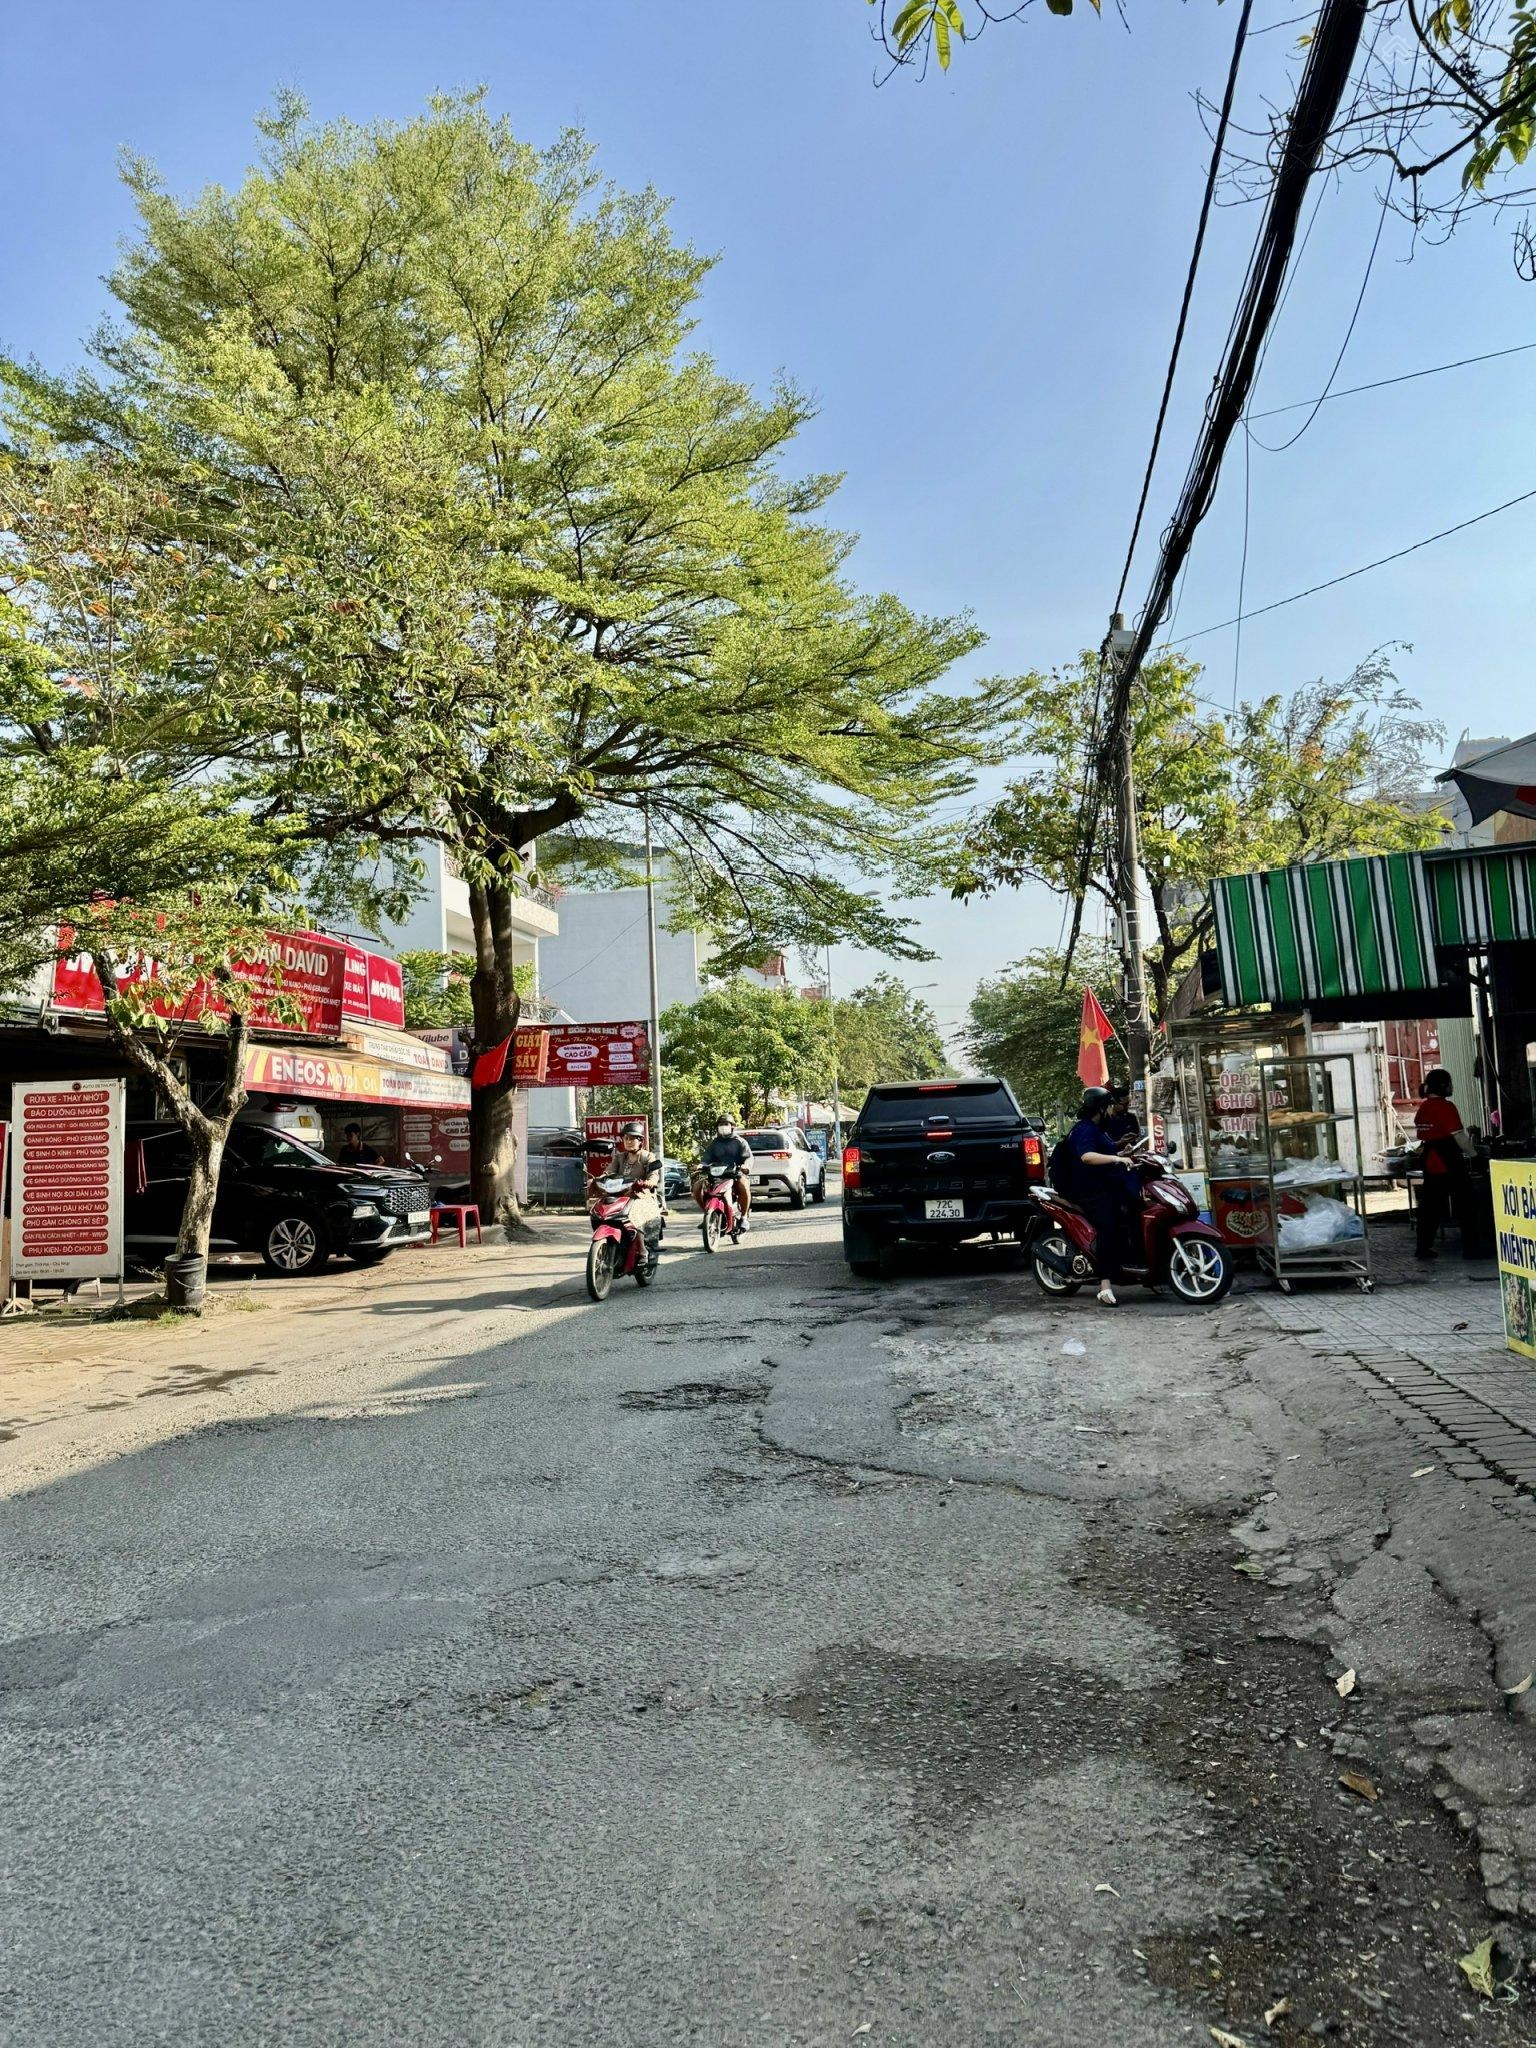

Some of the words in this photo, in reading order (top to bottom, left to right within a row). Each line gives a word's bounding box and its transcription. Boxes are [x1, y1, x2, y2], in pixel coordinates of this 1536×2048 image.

[285, 946, 329, 977] DAVID
[370, 978, 402, 1003] MOTUL
[272, 1056, 325, 1086] ENEOS
[397, 1080, 413, 1090] DAVID
[83, 1093, 104, 1101] NHỚT
[587, 1121, 613, 1134] THAY
[936, 1200, 953, 1208] 72C
[1502, 1178, 1520, 1217] XÔI
[930, 1209, 960, 1218] 224.30
